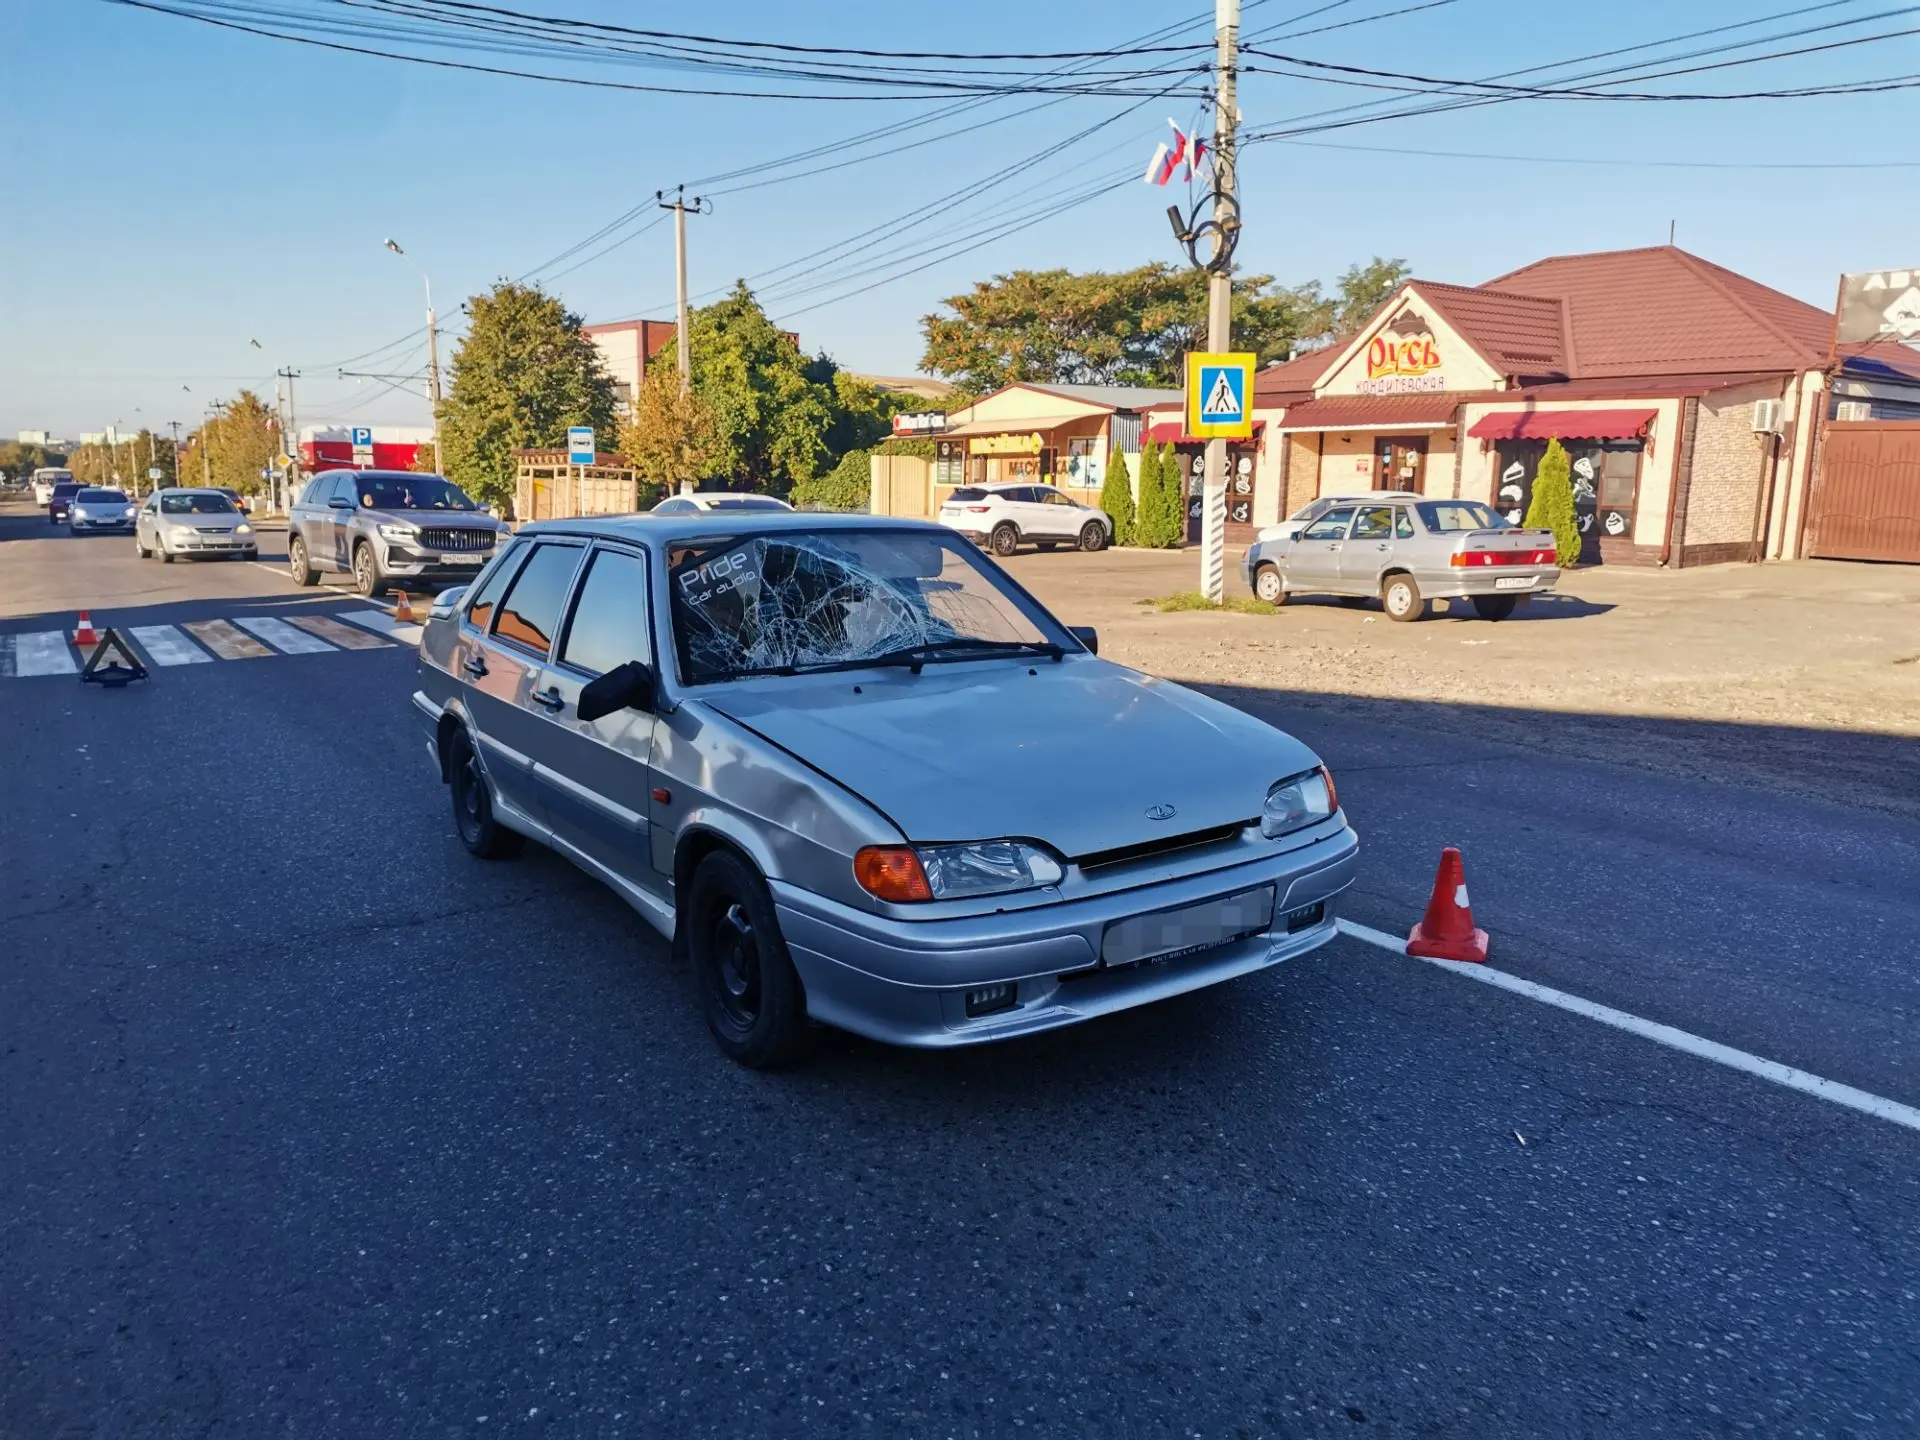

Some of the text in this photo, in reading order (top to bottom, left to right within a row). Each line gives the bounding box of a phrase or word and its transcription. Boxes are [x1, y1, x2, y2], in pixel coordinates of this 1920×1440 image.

[357, 430, 369, 444] P
[679, 553, 747, 592] Pride
[689, 570, 756, 605] car audio
